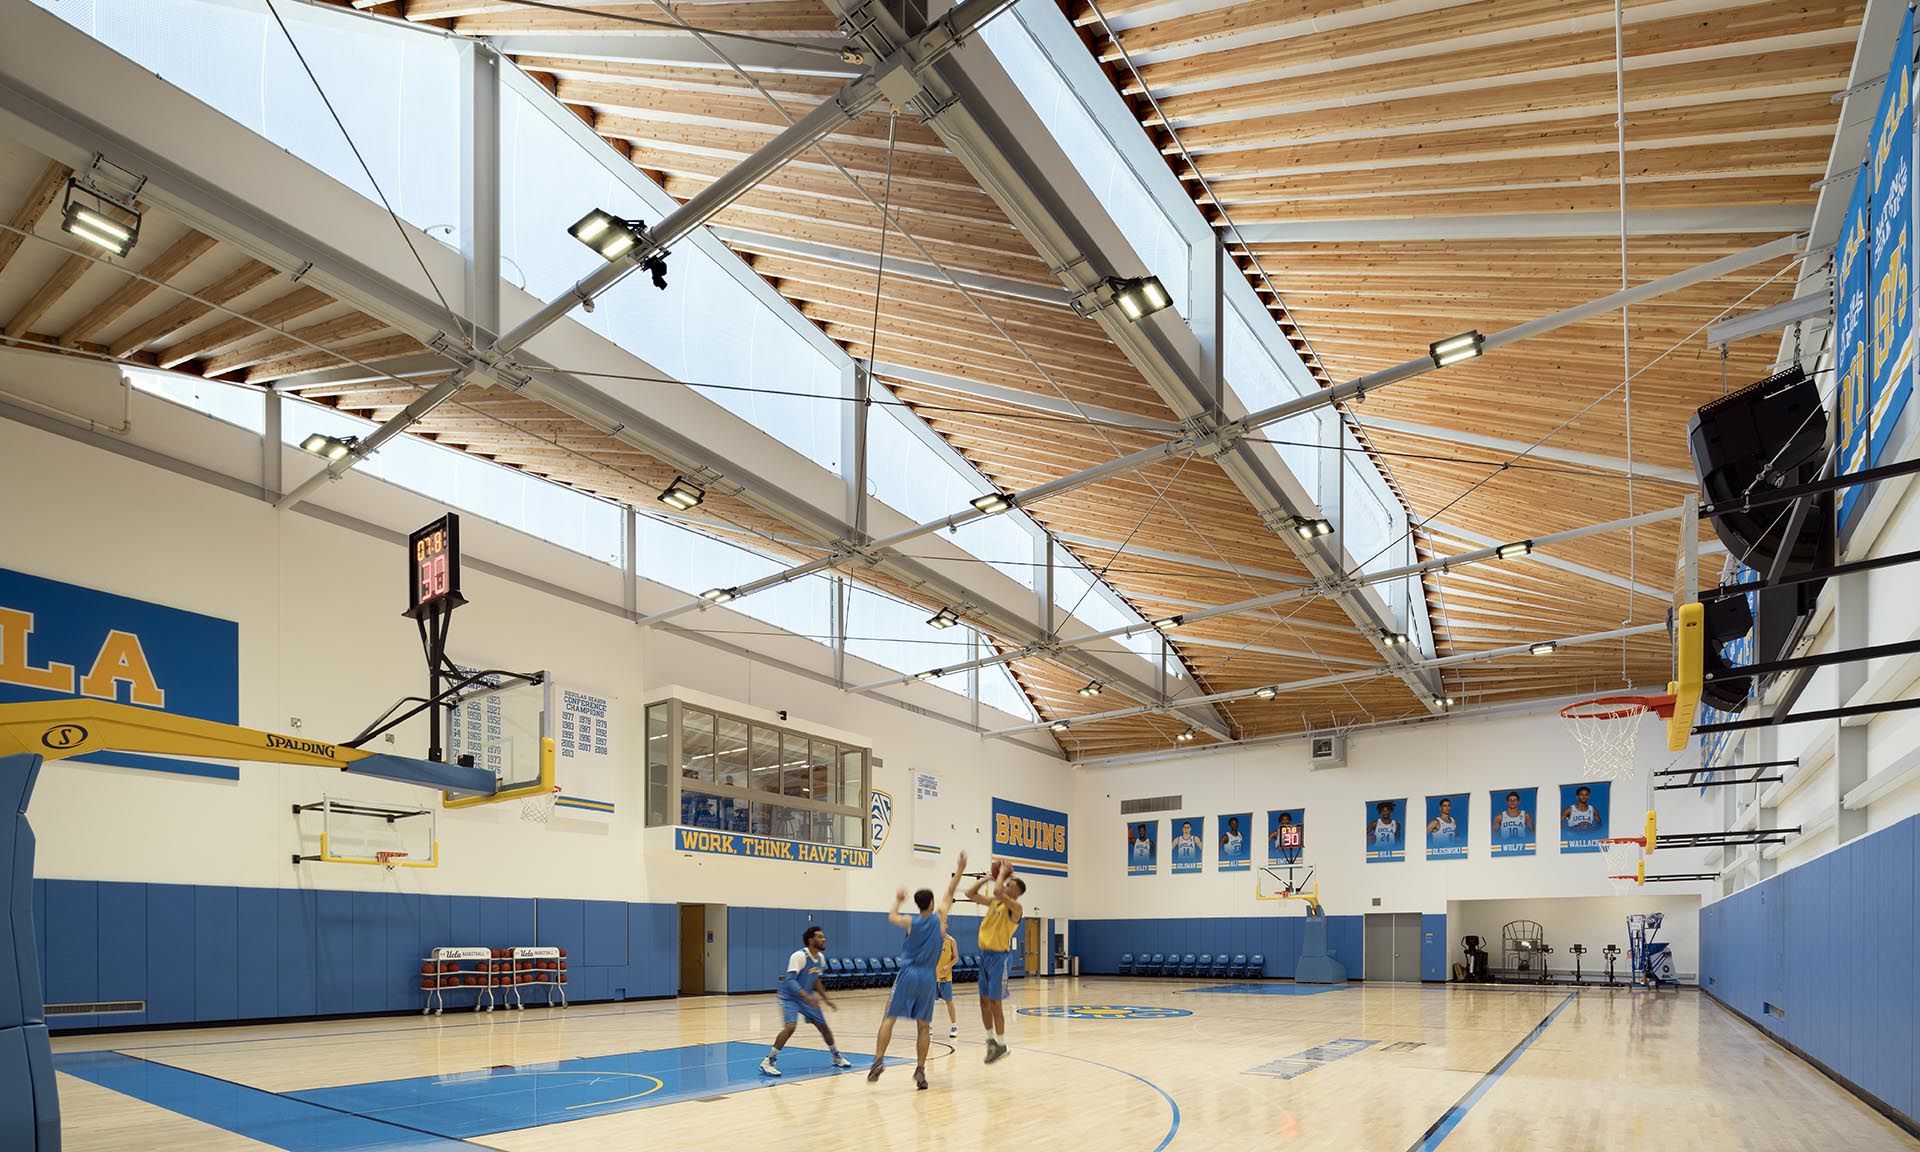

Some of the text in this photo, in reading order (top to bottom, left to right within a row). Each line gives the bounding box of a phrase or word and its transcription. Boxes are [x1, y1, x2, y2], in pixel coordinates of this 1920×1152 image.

[1874, 64, 1909, 194] UCLA
[1839, 207, 1866, 305] UCLA
[1874, 220, 1907, 383] 1975
[422, 554, 446, 601] 30
[564, 696, 607, 712] CONFERENCE
[566, 703, 604, 718] CHAMPIONS
[562, 711, 574, 721] 1977
[266, 733, 336, 758] SPALDING
[1503, 820, 1523, 828] UCLA
[995, 812, 1065, 853] BRUINS
[1284, 833, 1299, 845] 30
[1380, 833, 1390, 842] 24
[1508, 828, 1518, 838] 10
[681, 830, 870, 867] WORK, THINK, HAVE FUN!
[1503, 843, 1524, 851] WULFF
